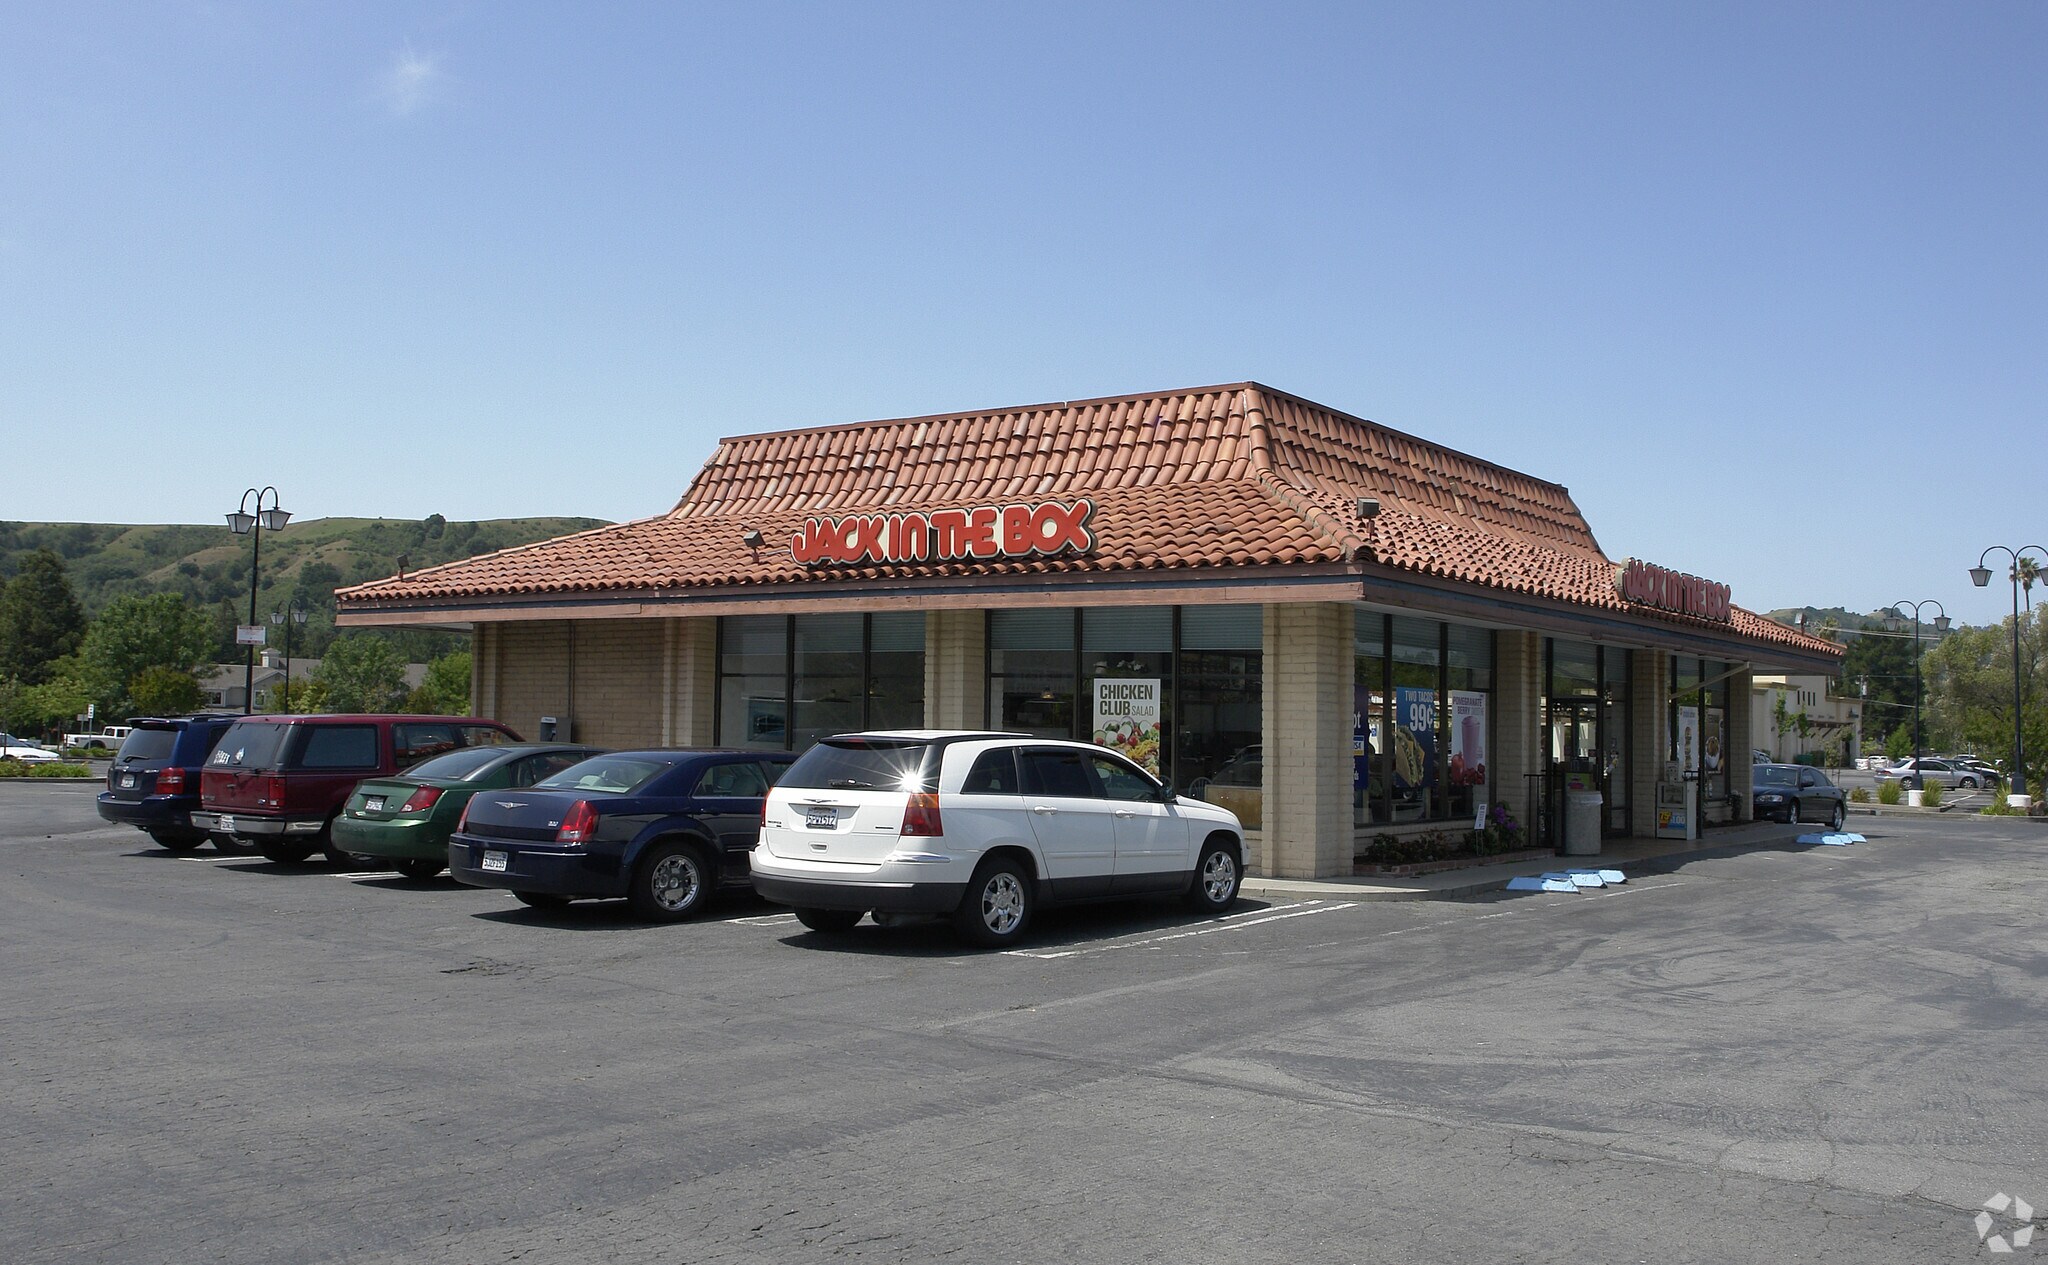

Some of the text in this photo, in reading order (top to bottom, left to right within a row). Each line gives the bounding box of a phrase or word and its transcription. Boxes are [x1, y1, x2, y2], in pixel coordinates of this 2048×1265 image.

[791, 499, 1092, 562] JACK IN THE BOX
[1623, 557, 1664, 608] JACK
[1681, 573, 1705, 617] THE
[1705, 579, 1731, 623] BOX
[1100, 684, 1153, 700] CHICKEN
[1405, 690, 1434, 703] TWO TACOS
[1100, 701, 1154, 716] CLUB SALAD
[1409, 703, 1433, 732] 99¢
